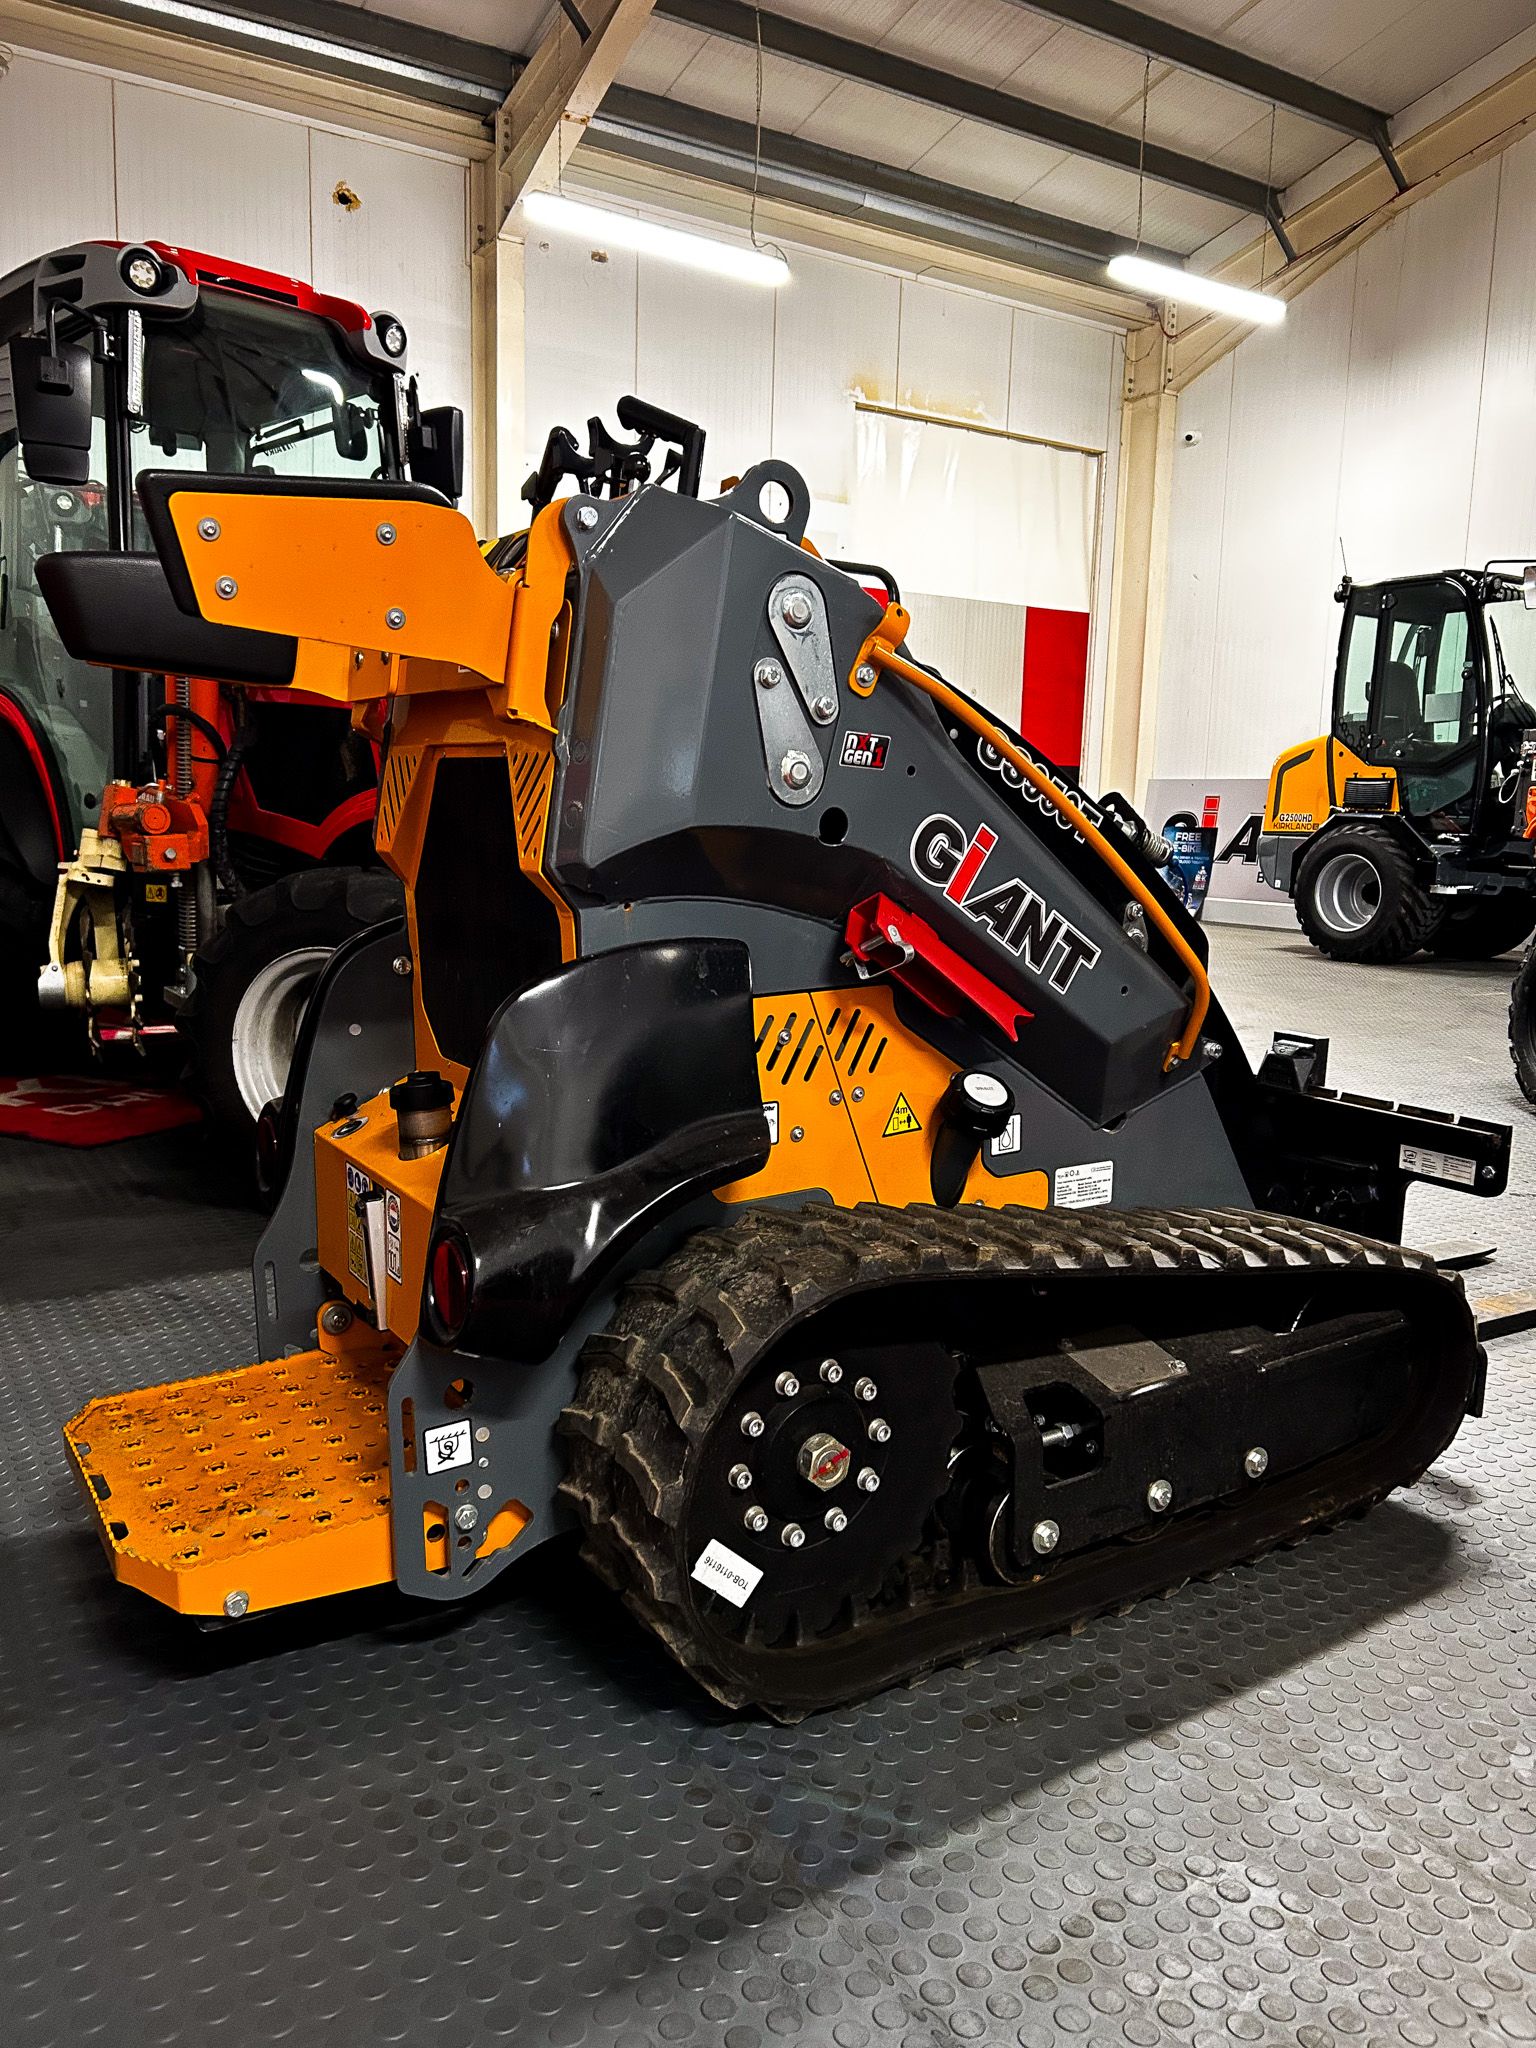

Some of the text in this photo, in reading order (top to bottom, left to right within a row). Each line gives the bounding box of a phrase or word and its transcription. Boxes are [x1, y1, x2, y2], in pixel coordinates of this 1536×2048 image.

[1279, 813, 1313, 823] G2500HD
[1175, 832, 1202, 842] FREE
[895, 1106, 908, 1115] 4m
[703, 1555, 750, 1591] TOB-0116116
